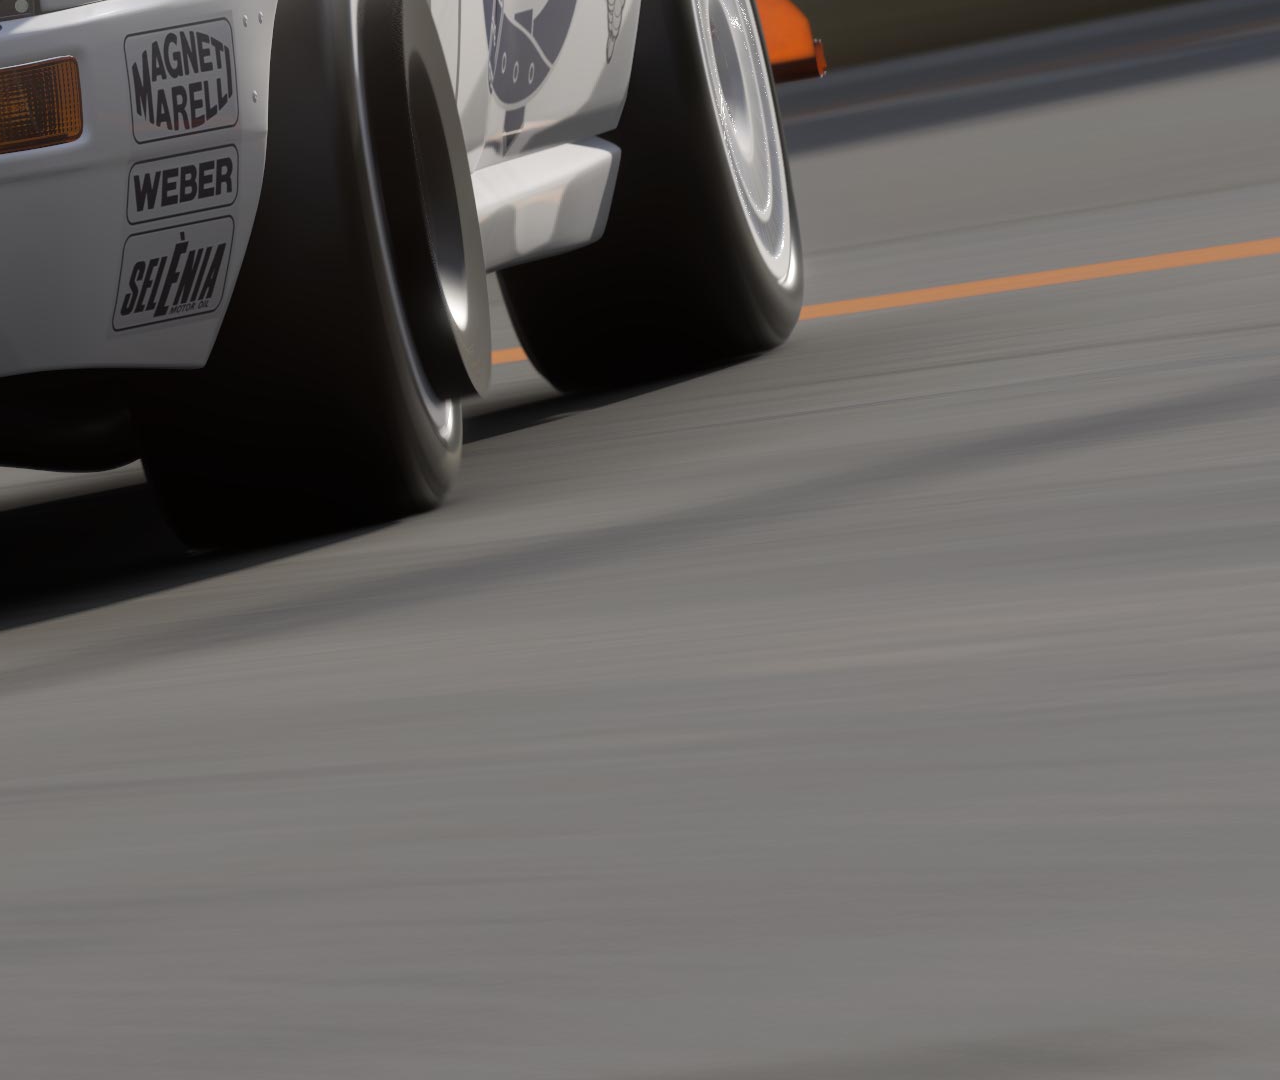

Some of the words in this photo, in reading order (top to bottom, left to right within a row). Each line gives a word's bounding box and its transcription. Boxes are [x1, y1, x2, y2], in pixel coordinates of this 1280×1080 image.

[132, 30, 233, 100] MAGNETI
[132, 64, 233, 131] MARELLI
[133, 156, 233, 212] WEBER
[120, 231, 227, 318] SELÈNIA
